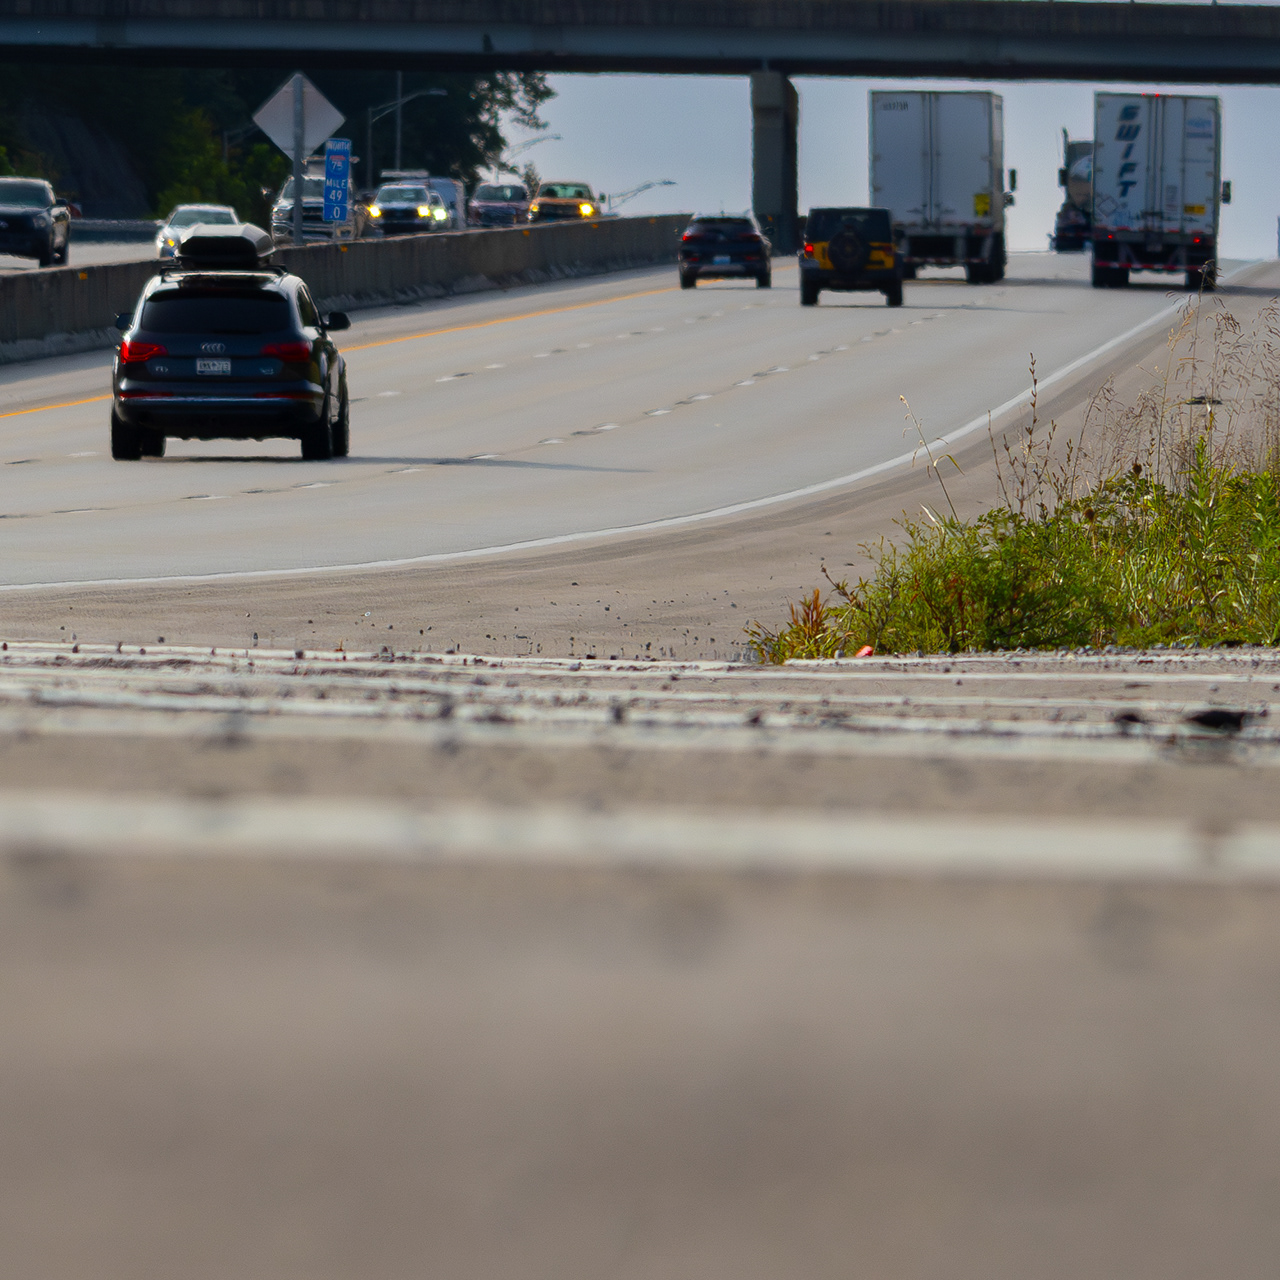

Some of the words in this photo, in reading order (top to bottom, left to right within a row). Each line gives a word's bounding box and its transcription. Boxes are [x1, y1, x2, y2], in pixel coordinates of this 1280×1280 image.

[1116, 105, 1141, 198] SWIFT
[331, 161, 343, 171] 75
[326, 179, 346, 189] MILE
[329, 190, 342, 201] 49
